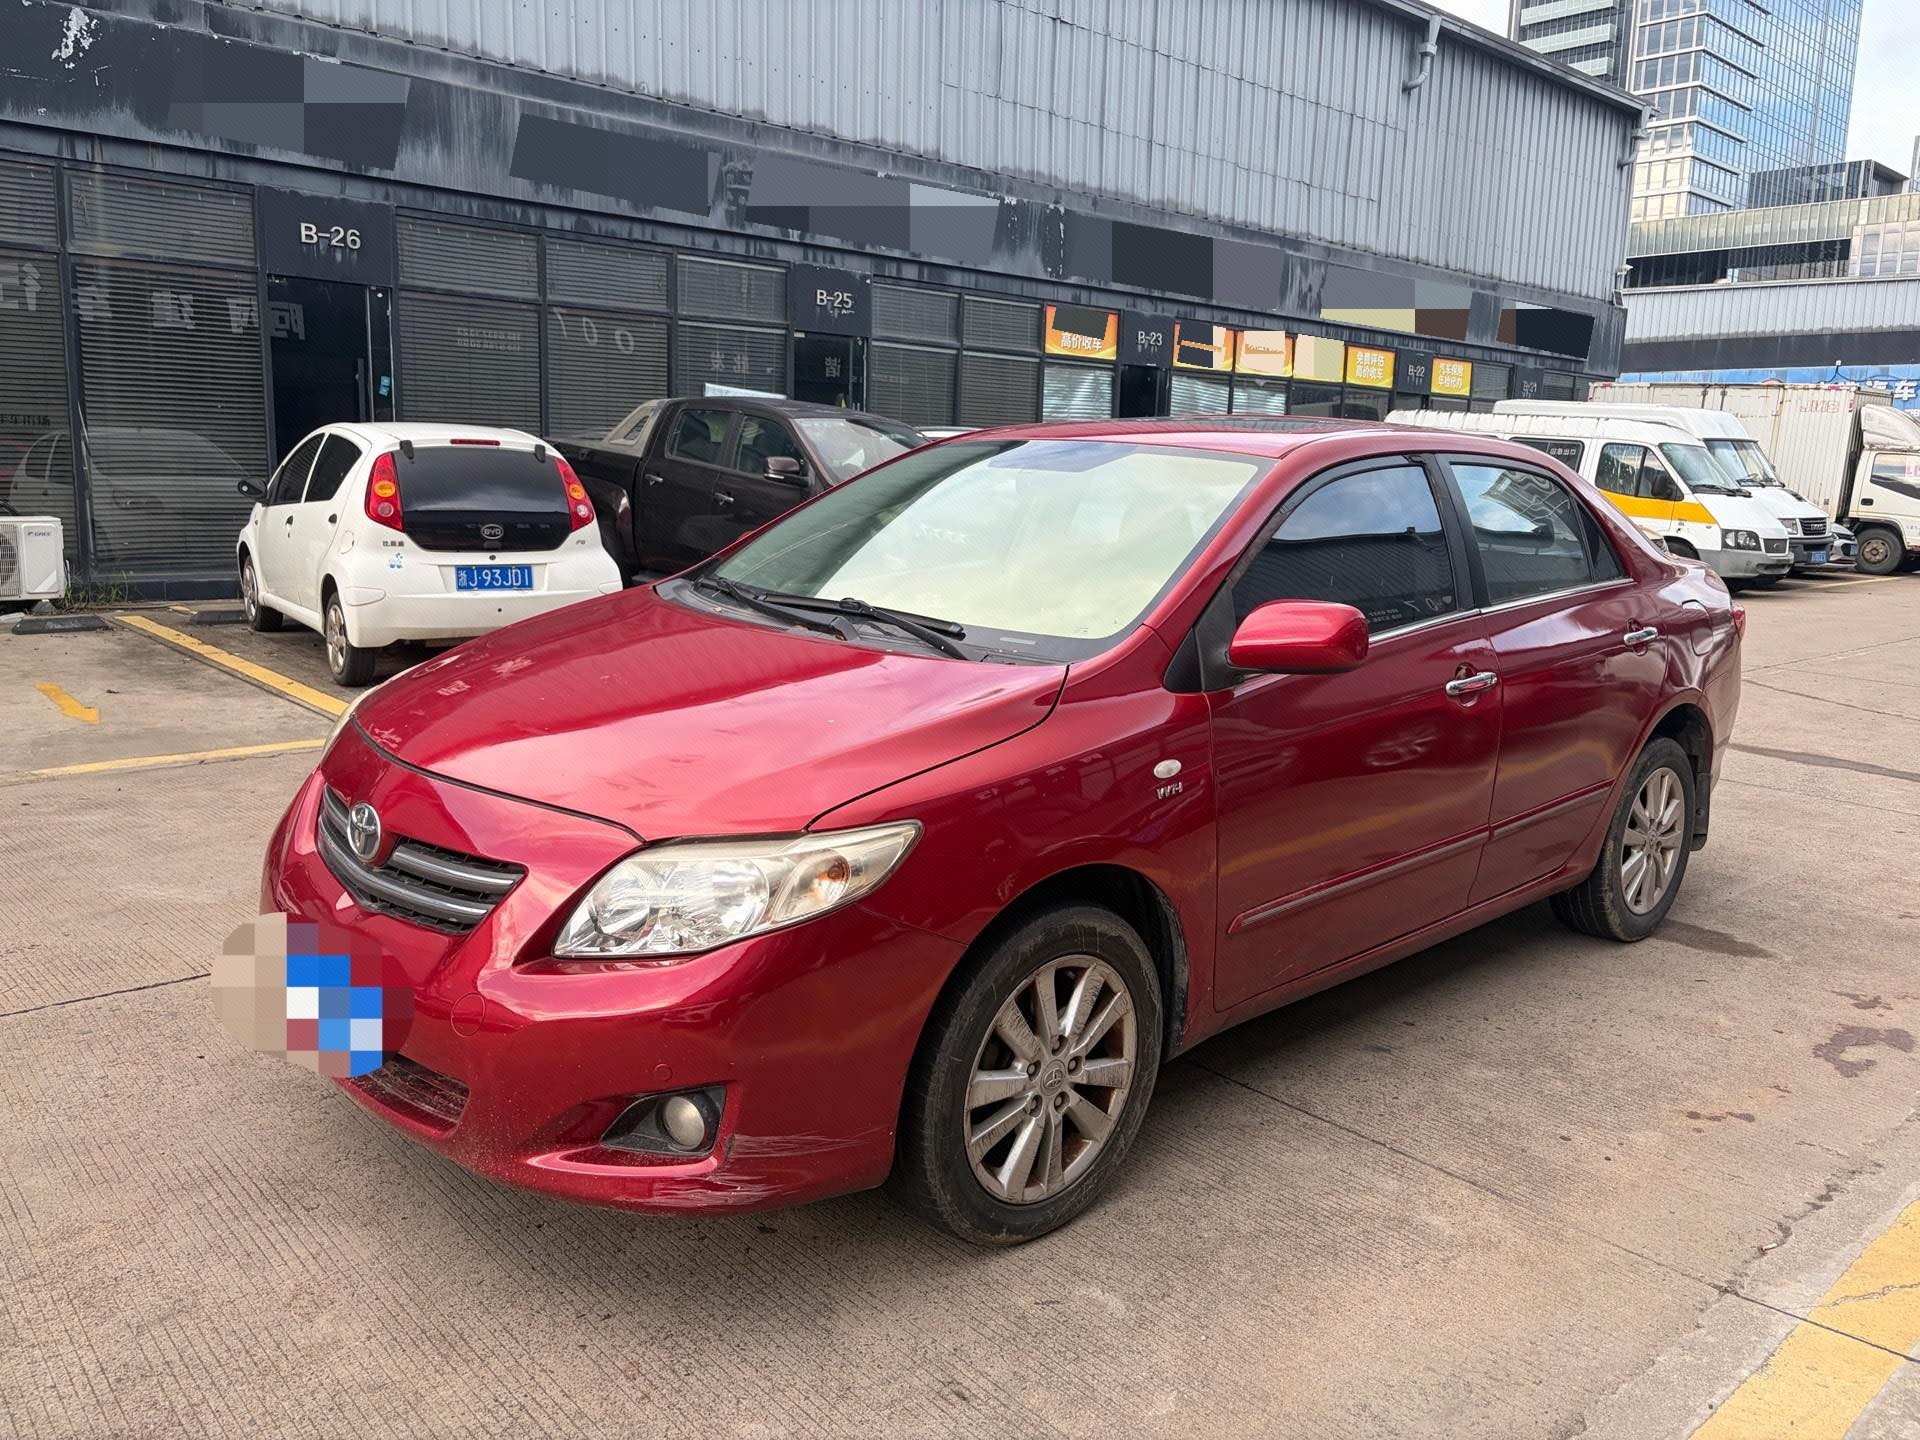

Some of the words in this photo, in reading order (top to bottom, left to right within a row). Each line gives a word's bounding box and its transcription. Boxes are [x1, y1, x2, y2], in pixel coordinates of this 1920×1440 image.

[300, 222, 361, 249] B-26
[816, 289, 853, 309] B-25
[1061, 332, 1103, 351] 高价收车
[1138, 330, 1163, 346] B-23
[1408, 364, 1426, 377] B-22
